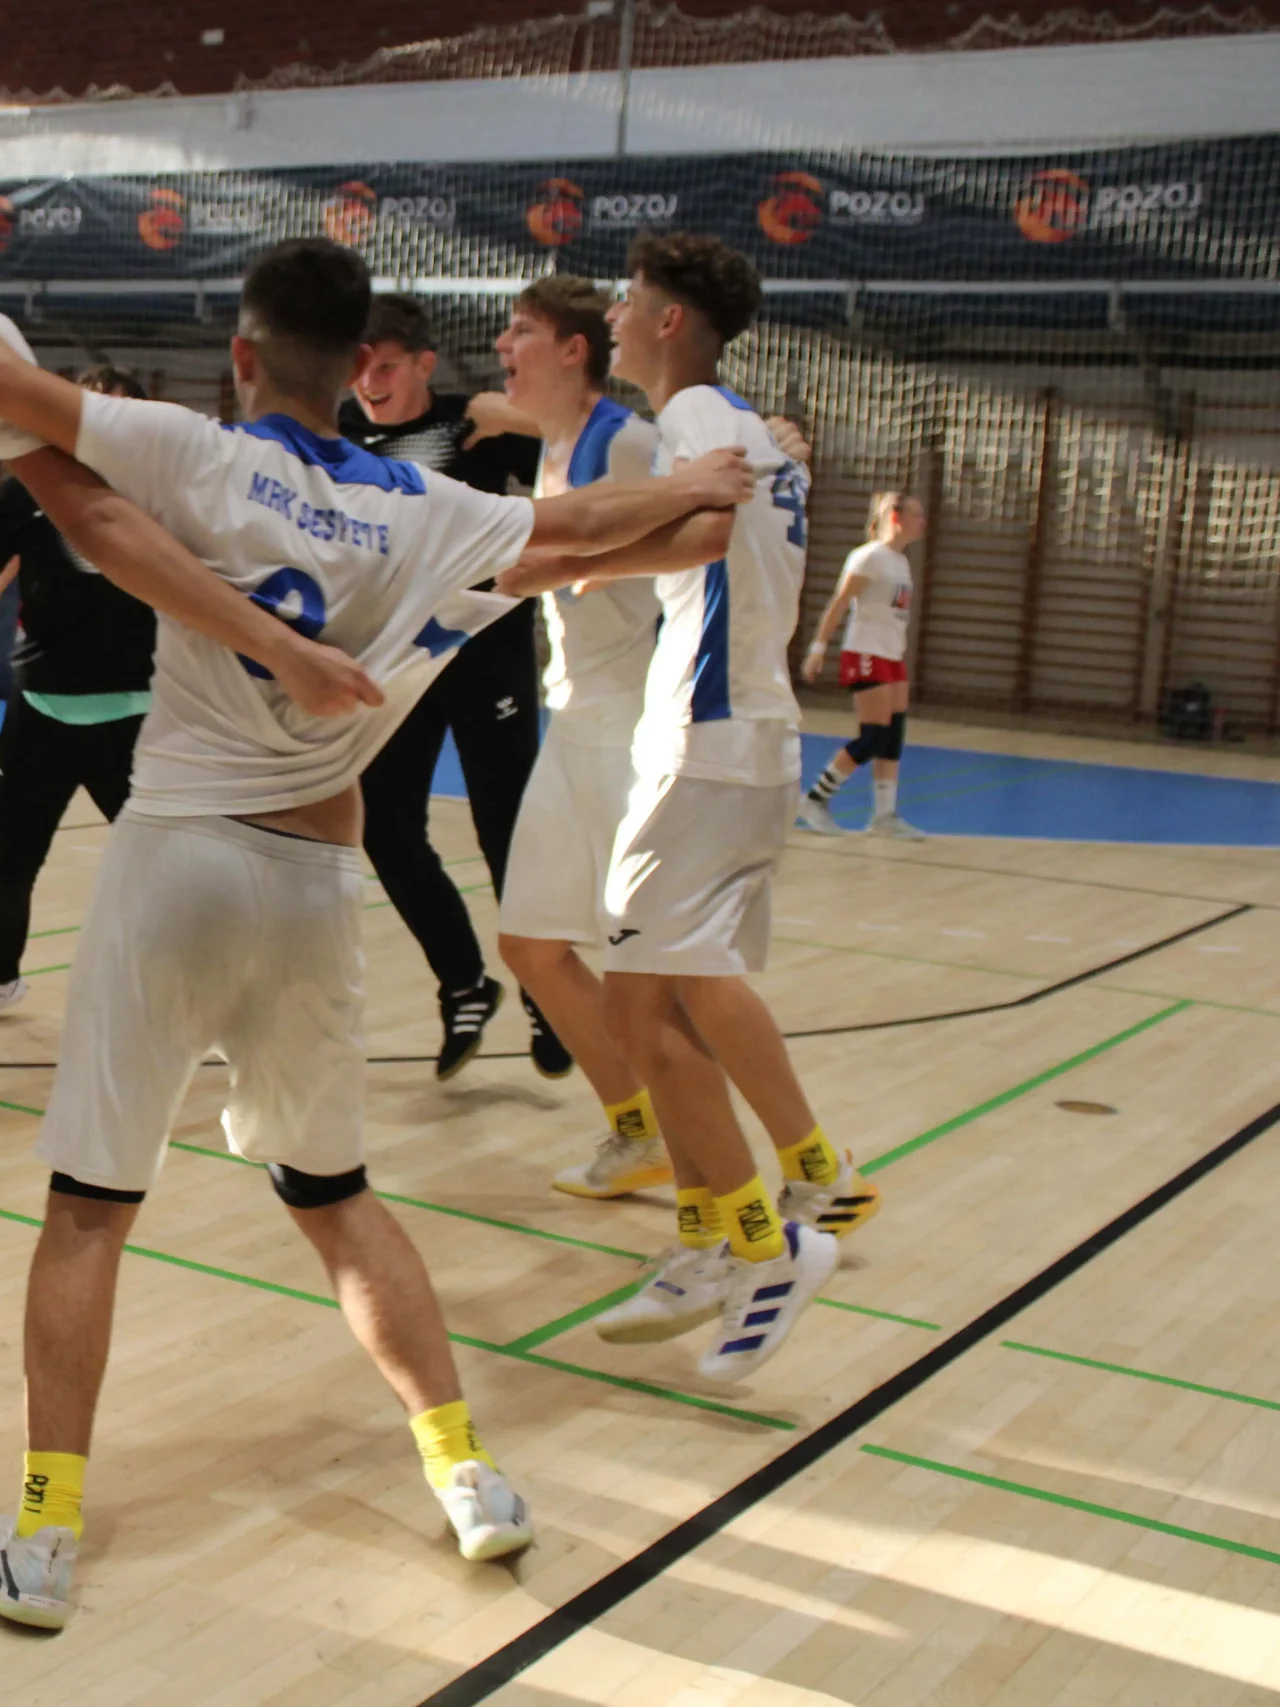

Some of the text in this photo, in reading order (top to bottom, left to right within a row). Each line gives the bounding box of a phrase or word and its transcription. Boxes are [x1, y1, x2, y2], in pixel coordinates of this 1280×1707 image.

[378, 196, 458, 219] POZOJ
[592, 195, 678, 219] POZOJ
[828, 190, 925, 215] POZOJ
[1096, 183, 1203, 212] POZOJ
[247, 471, 390, 556] MRK SESVETE
